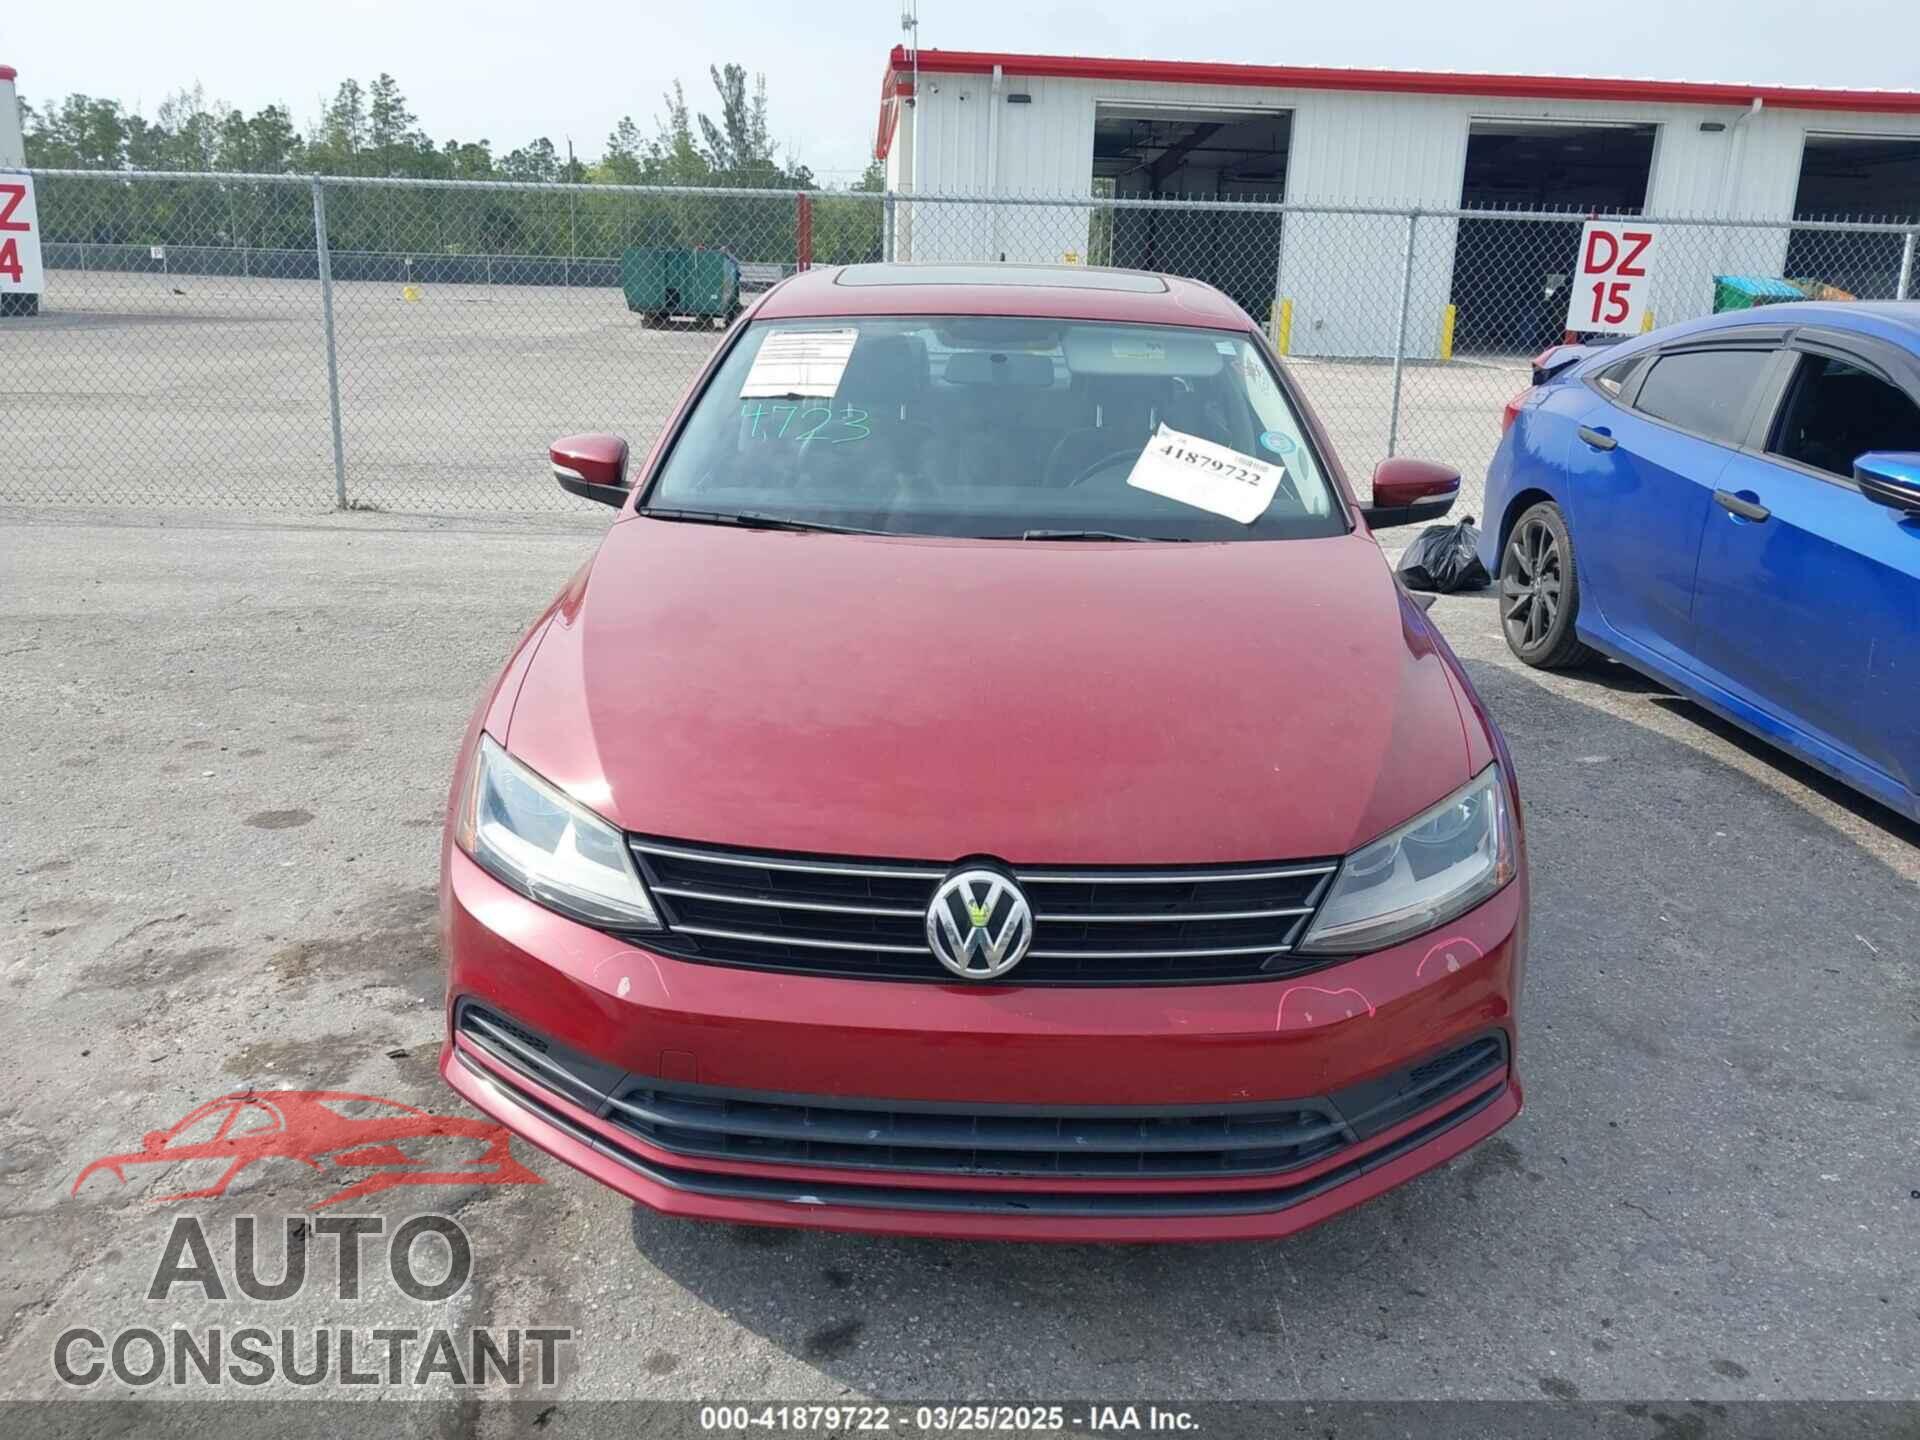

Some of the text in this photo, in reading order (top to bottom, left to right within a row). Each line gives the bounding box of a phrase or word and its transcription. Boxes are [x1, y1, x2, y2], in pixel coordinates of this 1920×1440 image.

[1584, 231, 1652, 276] DZ
[1592, 282, 1631, 323] 15
[1160, 445, 1261, 486] 41879722
